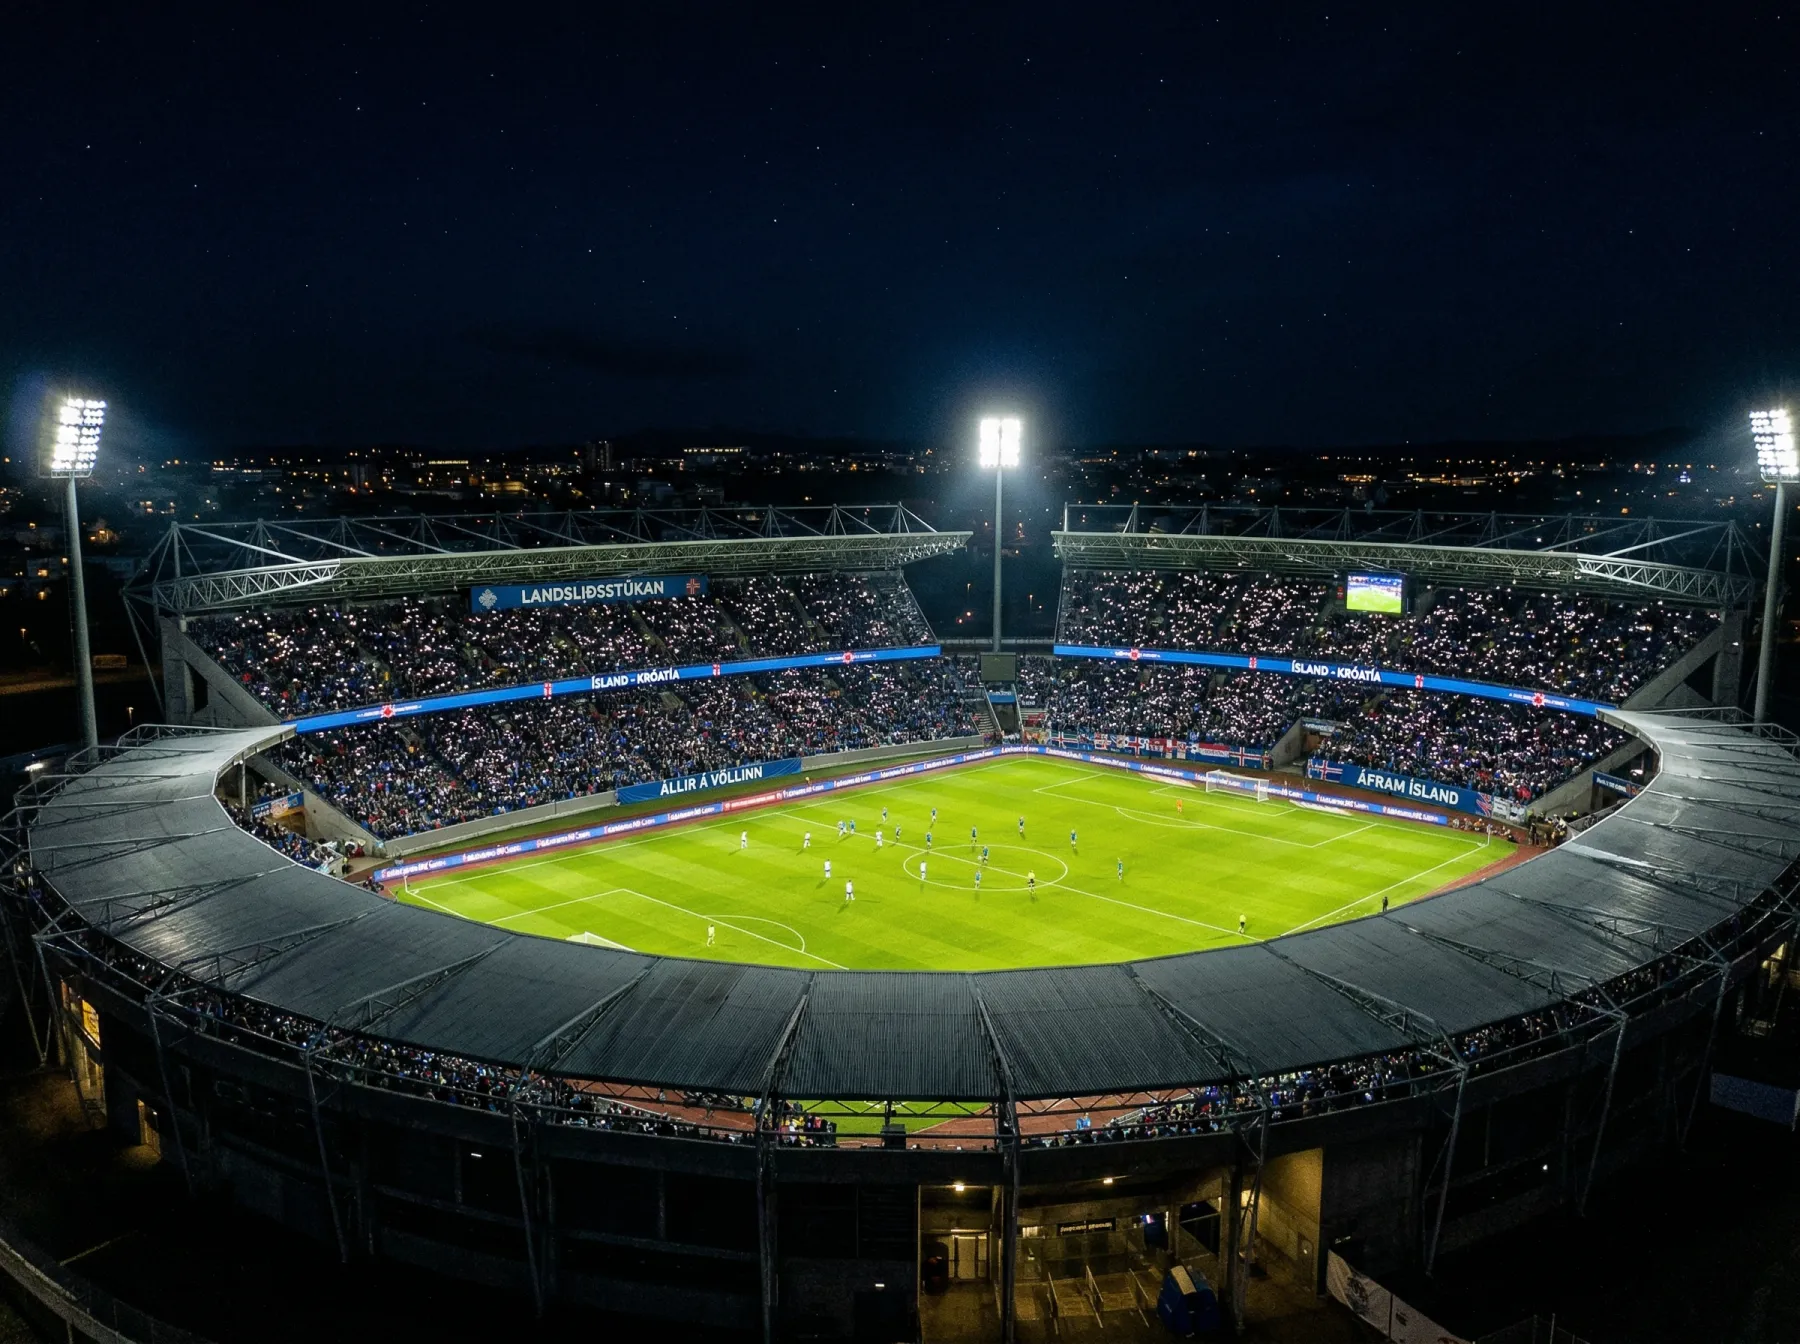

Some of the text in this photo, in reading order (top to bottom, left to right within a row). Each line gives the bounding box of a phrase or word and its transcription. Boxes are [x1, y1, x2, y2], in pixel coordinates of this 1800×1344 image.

[591, 675, 628, 689] ÍSLAND
[637, 667, 680, 684] KRÓATÍA
[1291, 660, 1329, 676] ÍSLAND
[1337, 666, 1381, 682] KRÓATÍA
[660, 780, 696, 796] ÁLLIR
[699, 772, 708, 788] Á
[1357, 768, 1459, 805] ÁFRAM ÍSLAND
